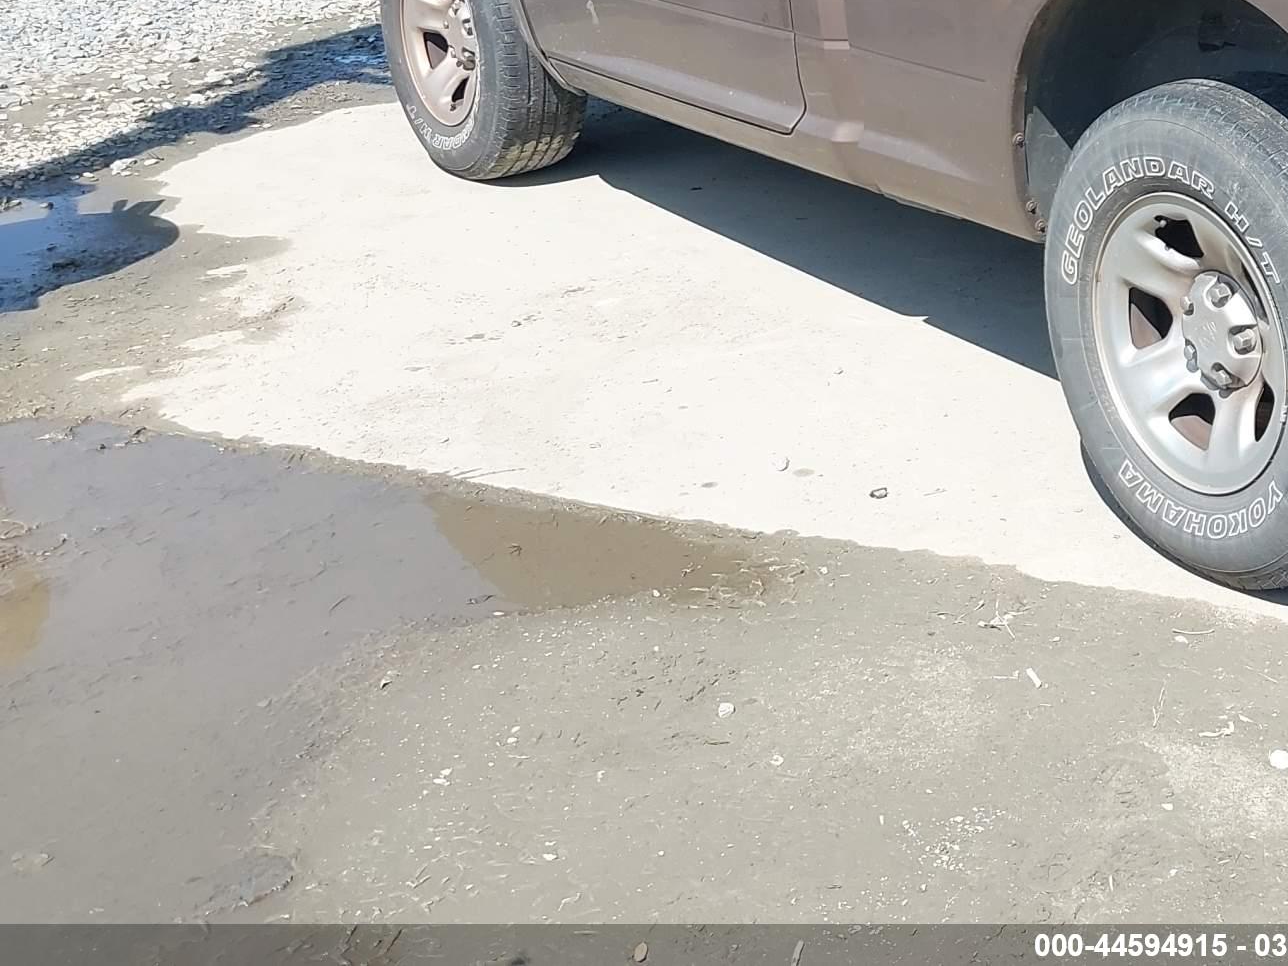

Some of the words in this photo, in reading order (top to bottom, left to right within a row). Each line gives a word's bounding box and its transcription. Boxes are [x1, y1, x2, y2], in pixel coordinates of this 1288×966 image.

[1061, 156, 1216, 286] GEOLANDAR
[1223, 200, 1281, 285] H/T
[1117, 458, 1284, 539] YOKOHAMA
